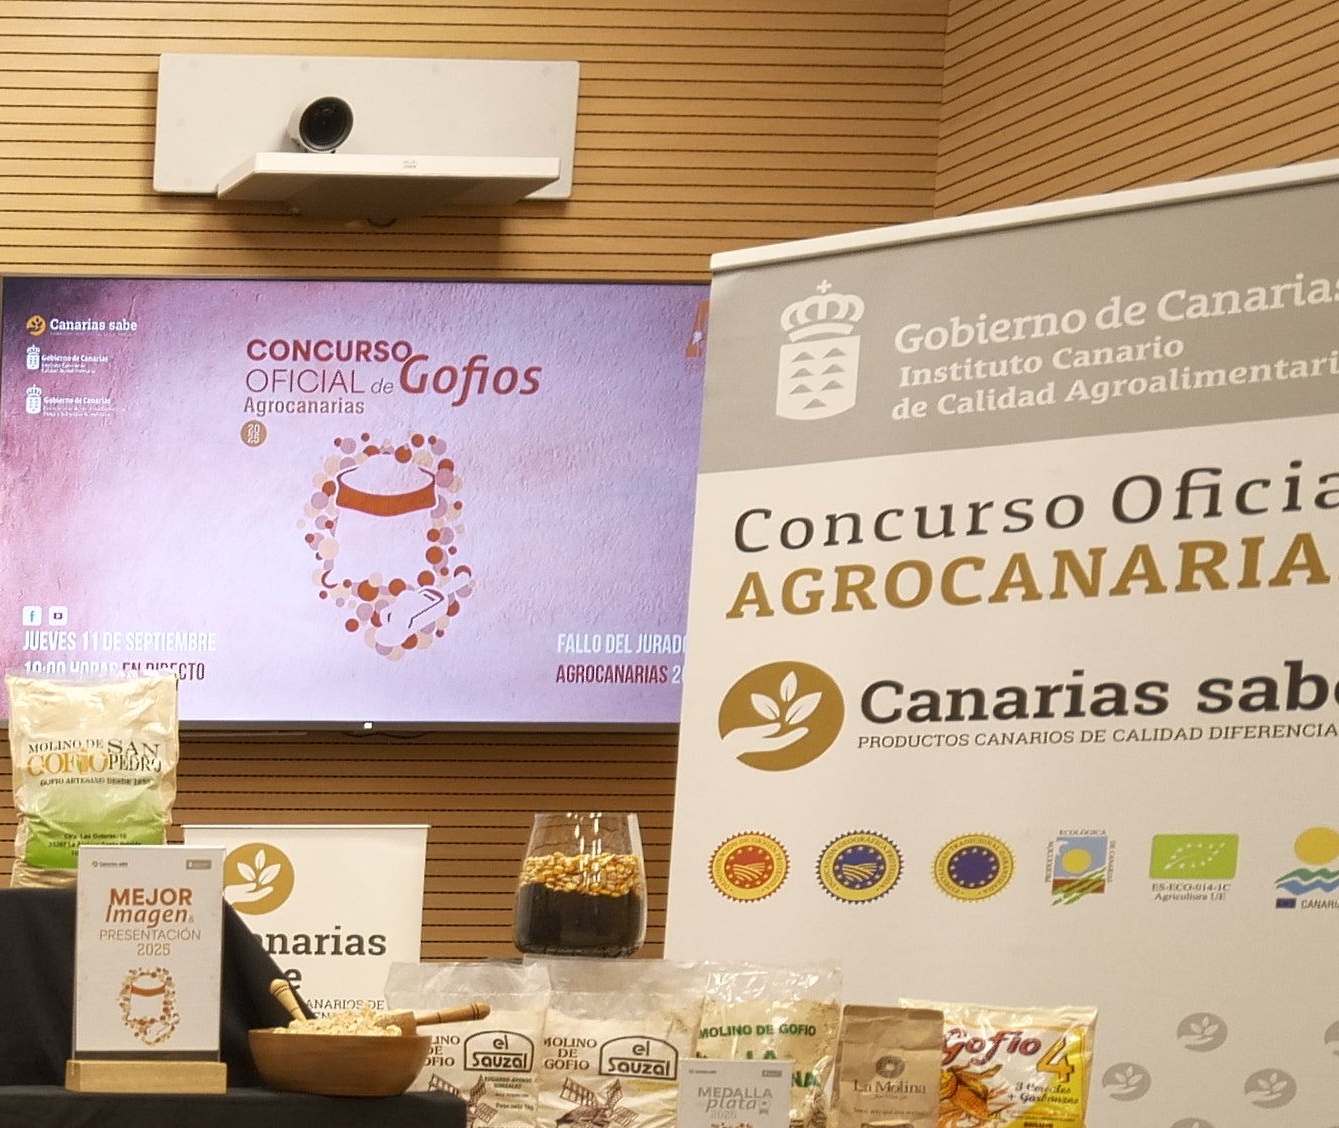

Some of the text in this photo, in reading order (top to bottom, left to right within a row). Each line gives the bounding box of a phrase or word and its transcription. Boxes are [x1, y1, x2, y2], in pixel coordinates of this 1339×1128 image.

[49, 317, 138, 333] Canarias sabe
[894, 308, 1087, 355] Gobierno
[1094, 296, 1147, 331] de
[246, 338, 413, 363] CONCURSO
[899, 336, 1185, 388] Instituto Canario
[245, 353, 542, 407] OFICIAL de Gofios
[243, 397, 365, 417] Agrocanarias
[891, 397, 929, 421] de
[937, 382, 1057, 417] Calidad
[733, 493, 1084, 553] Concurso
[725, 532, 1339, 620] AGROCANARIA
[22, 630, 217, 652] JUEVES 11 DE SEPTIEMBRE
[557, 632, 602, 654] FALLO
[605, 633, 632, 654] DEL
[556, 664, 668, 684] AGROCANARIAS
[860, 659, 1339, 725] Canarias sab
[858, 723, 1339, 749] PRODUCTOS CANARIOS DE CALIDAD DIFERENCIA
[28, 739, 104, 754] MOLINO DE
[107, 739, 160, 758] SAN
[108, 753, 162, 773] PEDRO
[109, 888, 193, 906] MEJOR
[105, 904, 188, 929] Imagen
[99, 926, 202, 941] PRESENTACIÓN
[137, 943, 171, 957] 2025
[699, 1023, 817, 1040] MOLINO DE GOFIO
[492, 1034, 510, 1050] el
[631, 1041, 651, 1057] el
[471, 1051, 529, 1070] Sauzal
[557, 1047, 579, 1059] DE
[941, 1027, 1076, 1083] Gofio 4
[544, 1058, 590, 1071] GOFIO
[607, 1056, 671, 1077] Sauzal
[697, 1086, 774, 1100] MEDALLA
[853, 1079, 927, 1095] La Molina
[705, 1096, 758, 1113] plata
